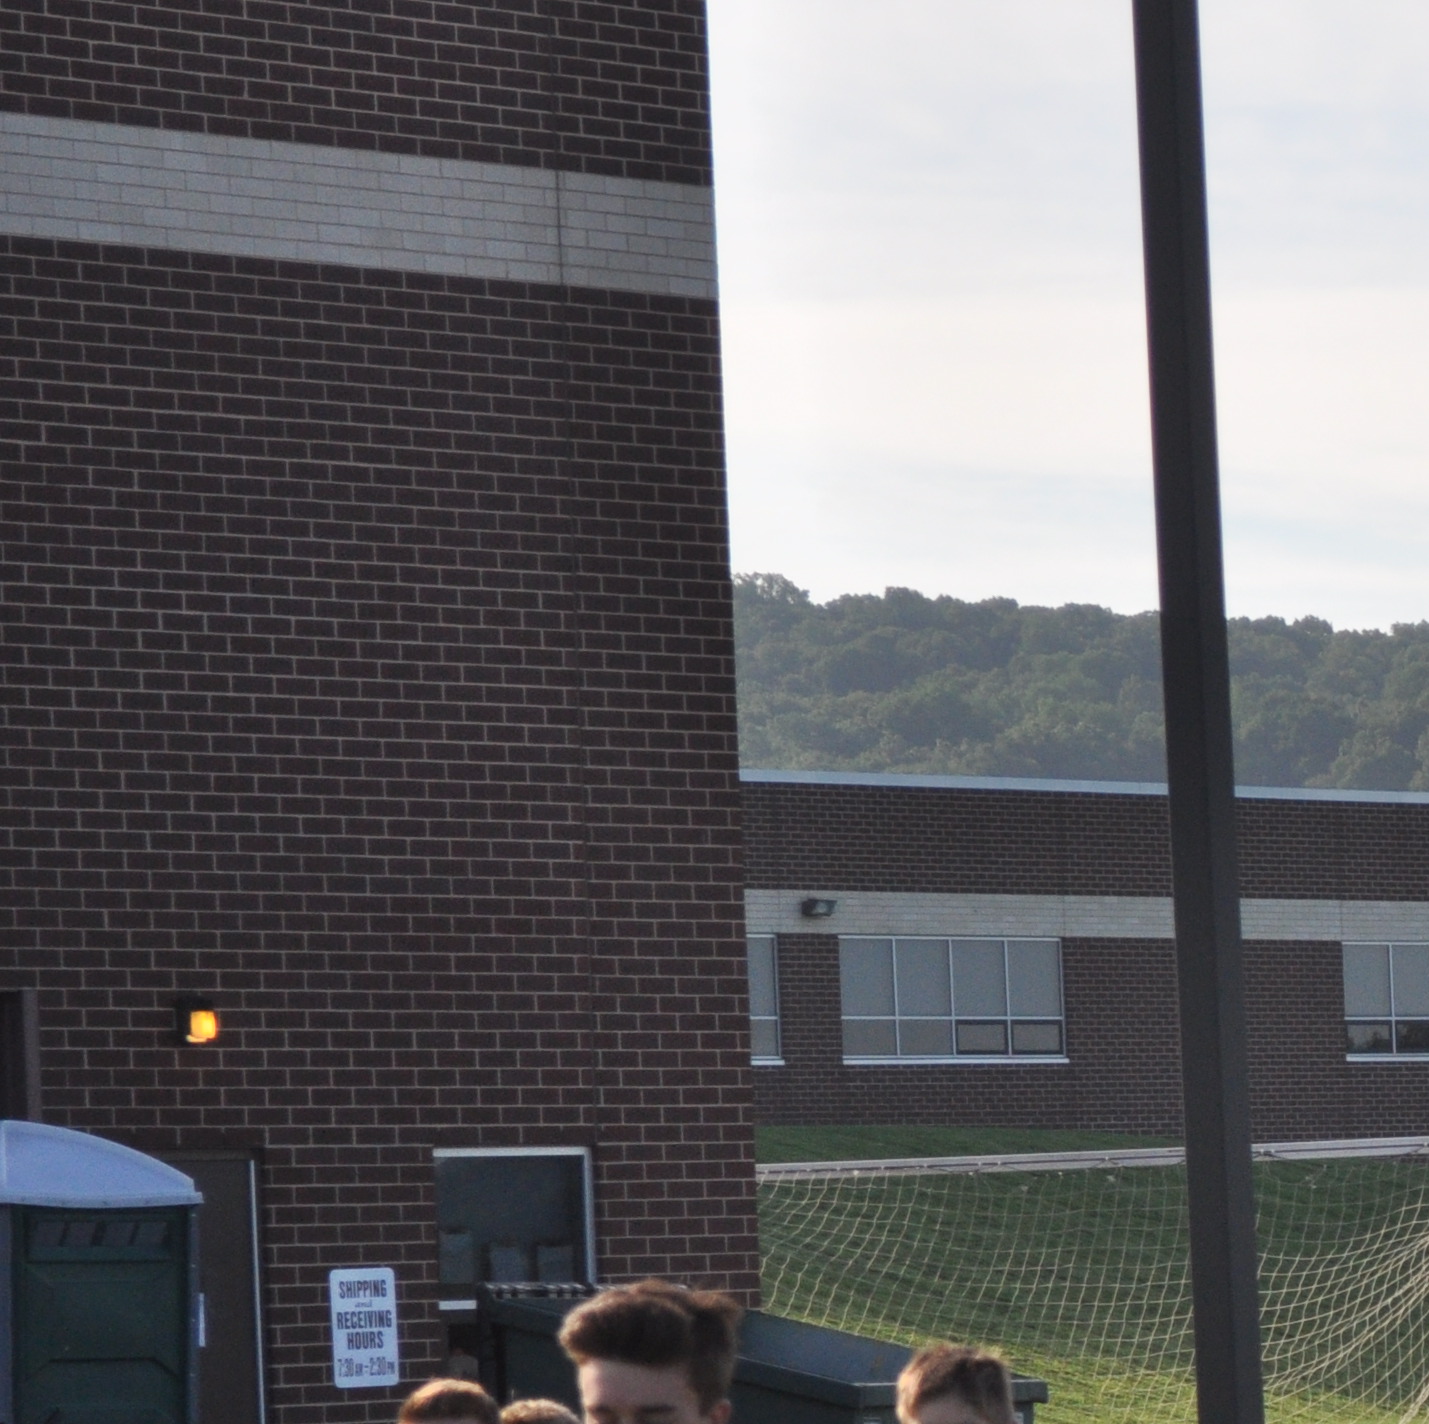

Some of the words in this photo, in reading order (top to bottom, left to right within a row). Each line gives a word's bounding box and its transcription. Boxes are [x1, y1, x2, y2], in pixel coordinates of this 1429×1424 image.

[338, 1279, 387, 1299] SHIPPING
[354, 1300, 373, 1308] and
[336, 1309, 393, 1330] RECEIVING
[347, 1331, 384, 1350] HOURS
